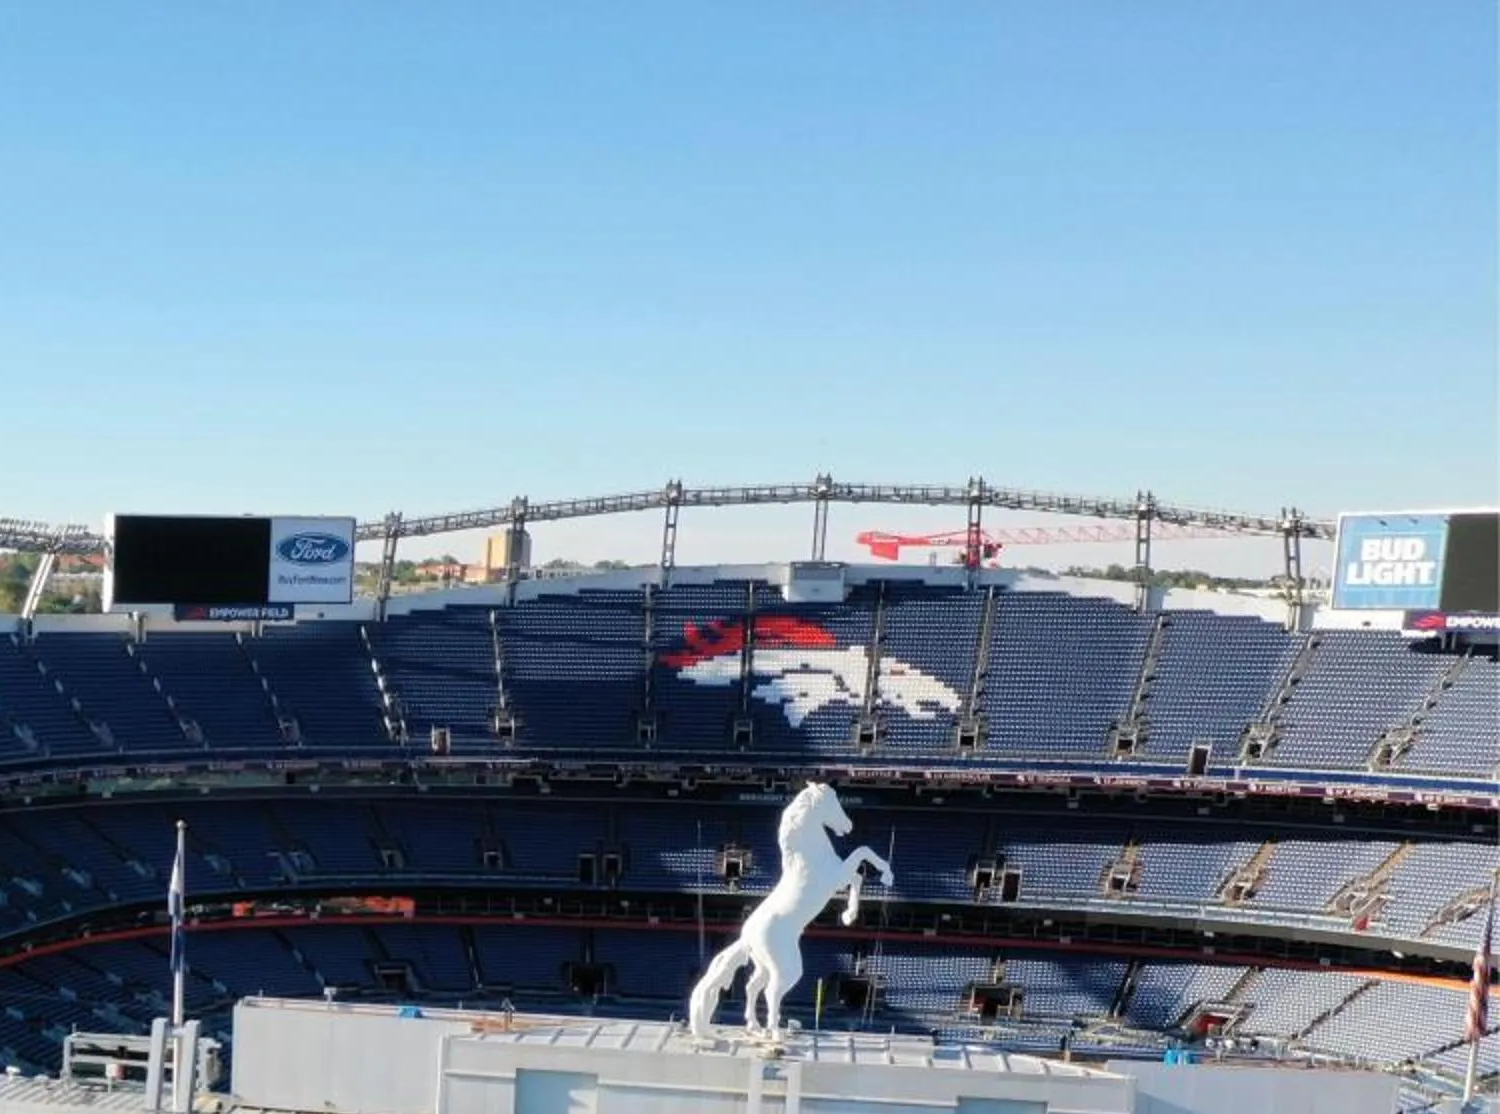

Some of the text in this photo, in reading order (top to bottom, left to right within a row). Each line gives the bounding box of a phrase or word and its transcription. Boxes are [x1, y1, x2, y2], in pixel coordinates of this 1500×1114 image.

[291, 537, 337, 560] Ford
[1361, 536, 1425, 561] BUD
[1346, 562, 1435, 585] LIGHT
[209, 606, 289, 619] EMPOWER FIELD
